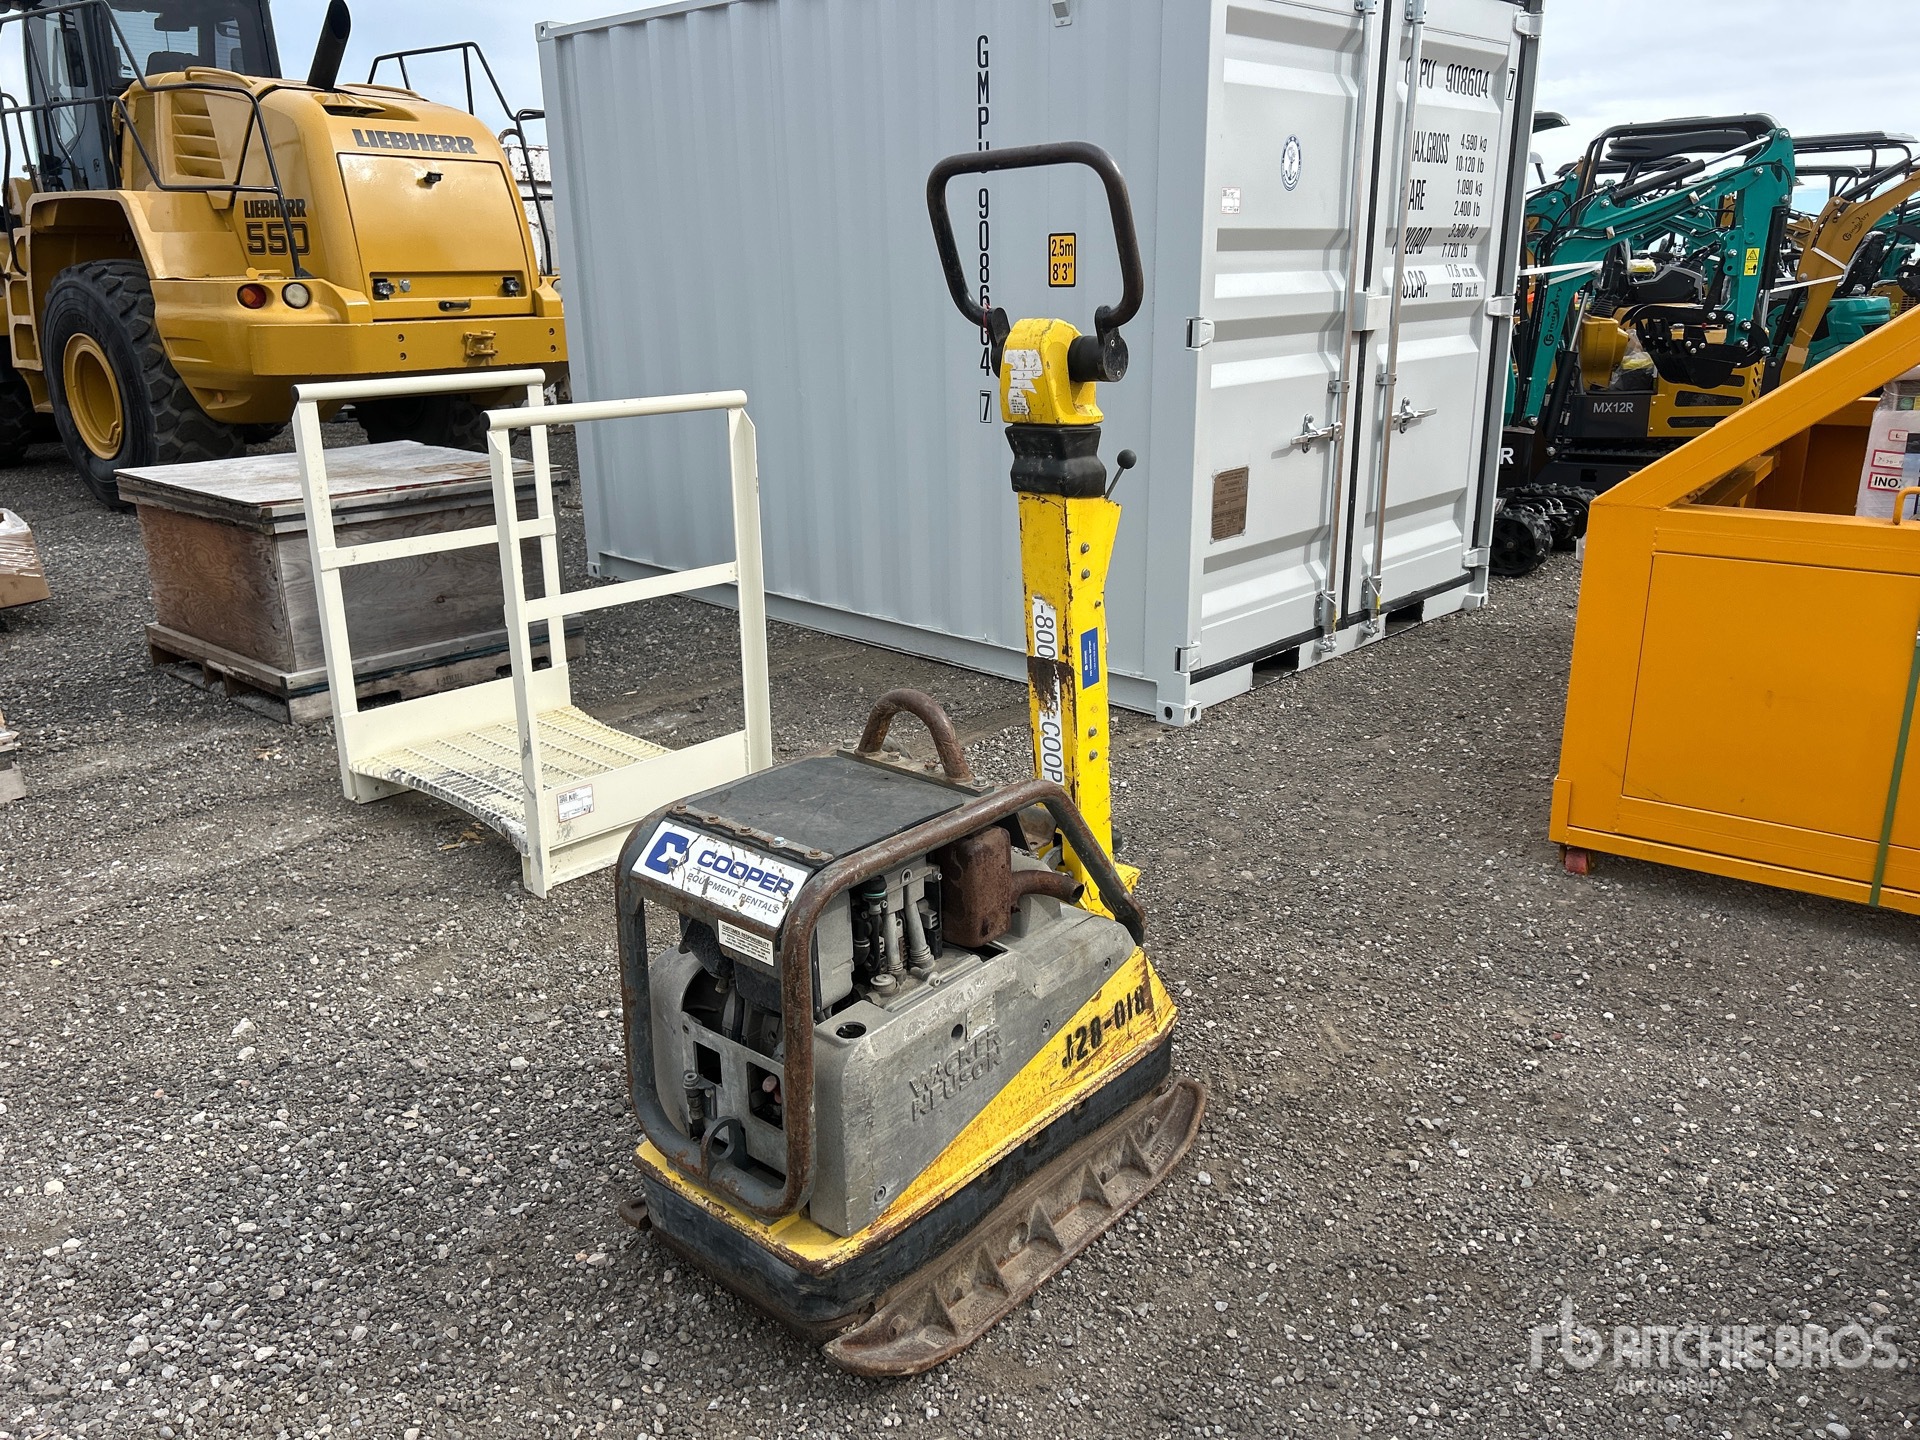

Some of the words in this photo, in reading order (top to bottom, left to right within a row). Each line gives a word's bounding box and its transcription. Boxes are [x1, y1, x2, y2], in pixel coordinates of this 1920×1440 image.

[1446, 63, 1489, 98] 908604
[1507, 69, 1516, 99] 7
[352, 128, 478, 154] LIEBHERR
[1480, 136, 1487, 152] kg
[1477, 157, 1485, 173] lb
[1407, 179, 1426, 210] ARE
[1475, 181, 1483, 196] kg
[244, 199, 307, 218] LIEBHRR
[1473, 202, 1480, 216] lb
[246, 222, 310, 255] 550
[1467, 226, 1478, 239] kg
[1460, 243, 1468, 258] lb
[1451, 282, 1463, 298] 620
[980, 391, 991, 421] 7
[1593, 402, 1634, 413] MX12R
[697, 850, 795, 897] COOPER
[740, 893, 780, 915] RENTALS
